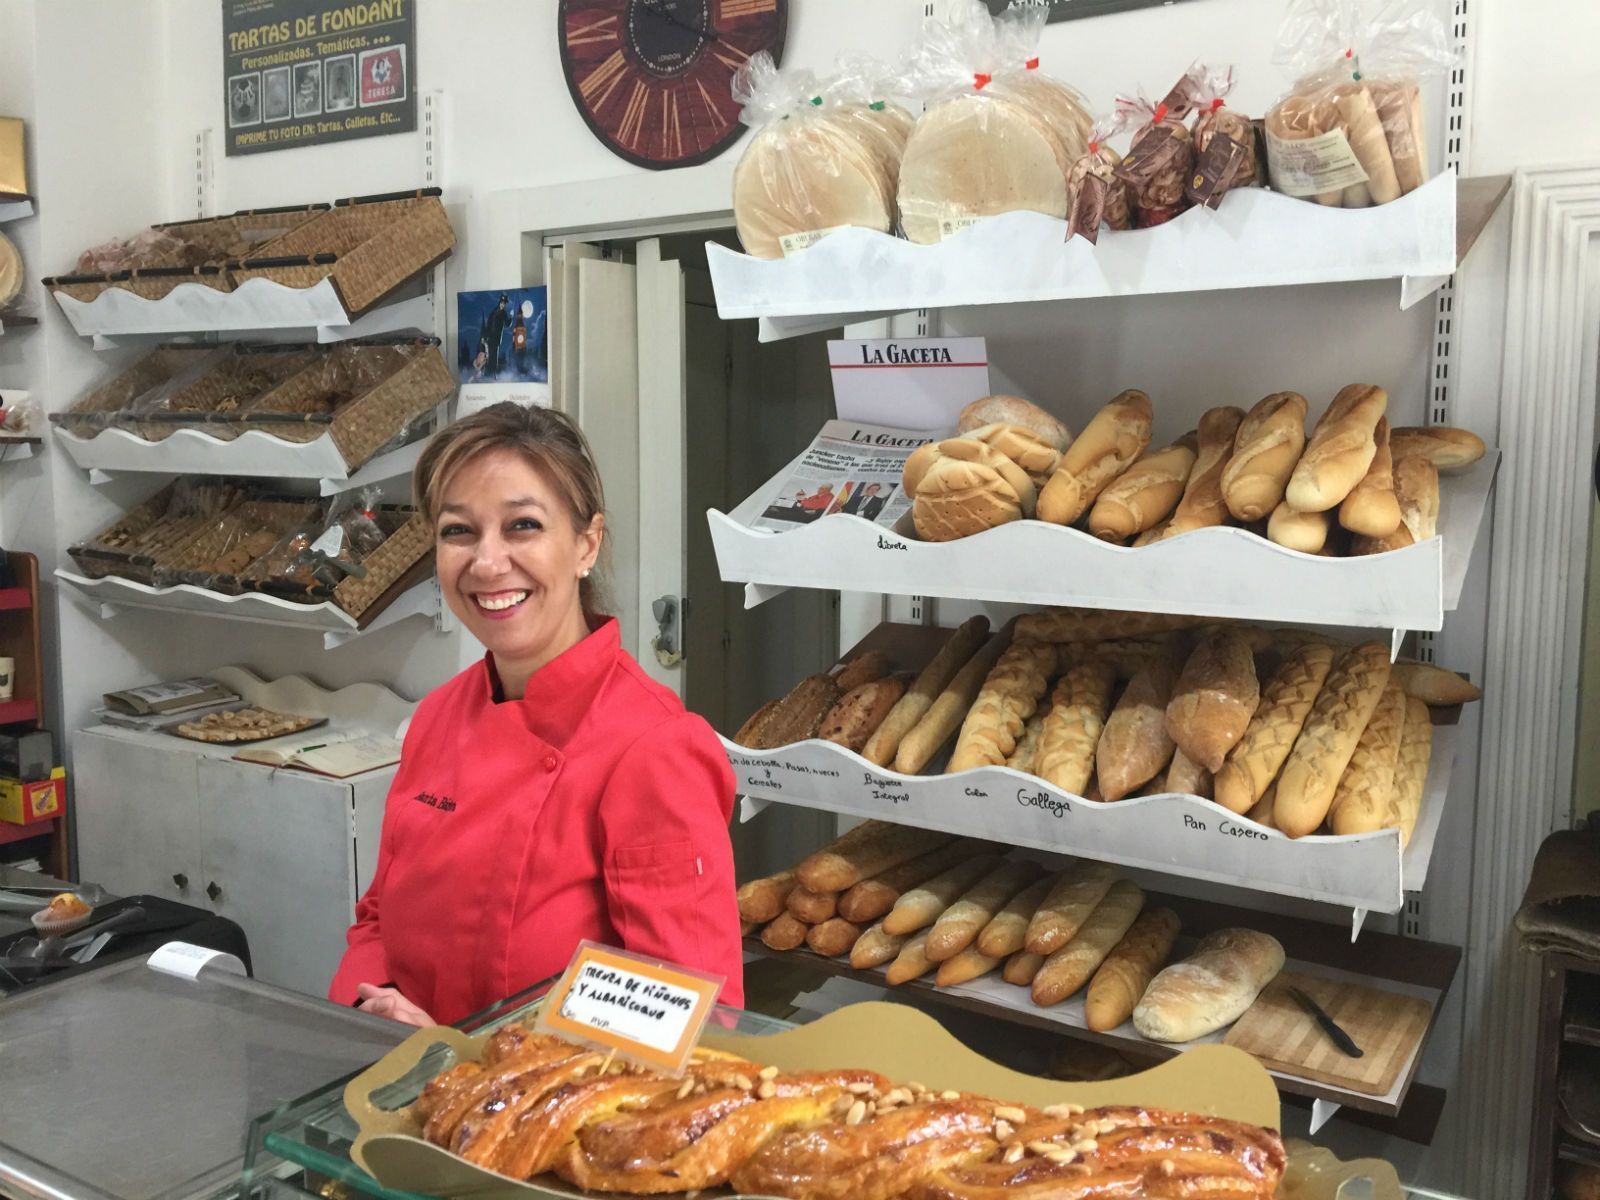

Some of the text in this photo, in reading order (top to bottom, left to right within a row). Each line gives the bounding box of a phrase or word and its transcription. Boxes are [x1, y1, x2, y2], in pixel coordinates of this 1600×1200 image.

[229, 0, 404, 52] TARTAS DE FONDANT
[658, 53, 681, 63] LONDON
[367, 85, 396, 99] TERESA
[235, 130, 267, 145] IMPRIME
[268, 127, 279, 140] TU
[280, 125, 300, 139] FOTO
[861, 343, 952, 364] LA GACETA
[851, 430, 934, 448] LA GACET
[872, 790, 910, 804] Integral
[1017, 788, 1072, 818] Gallega
[1183, 814, 1269, 841] Pan Casero
[578, 982, 589, 996] Y
[586, 966, 622, 986] TRENZA
[625, 978, 641, 993] DE
